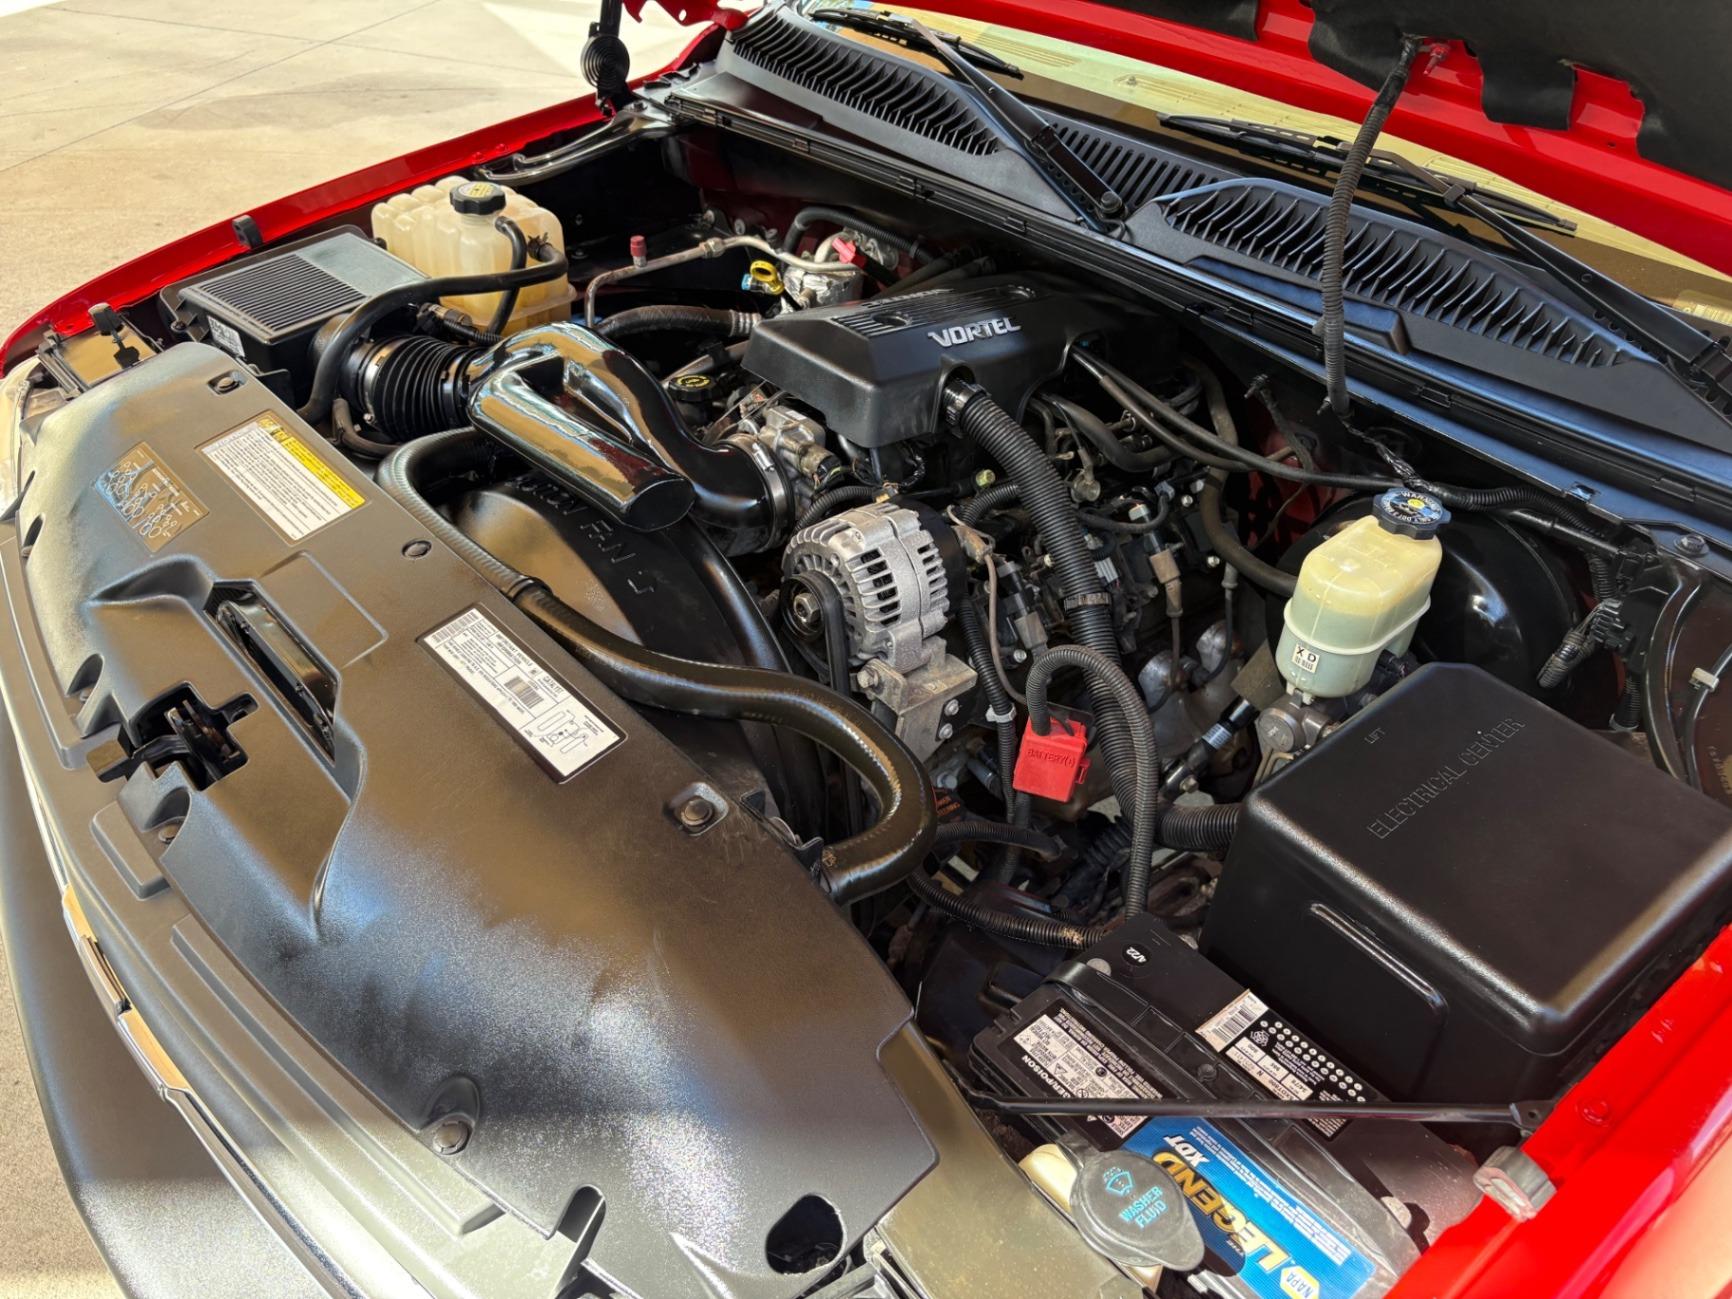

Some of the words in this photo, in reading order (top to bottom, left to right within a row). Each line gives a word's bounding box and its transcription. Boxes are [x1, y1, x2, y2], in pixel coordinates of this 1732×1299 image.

[1364, 727, 1387, 744] LIFT
[1366, 765, 1468, 839] ELECTRICAL
[1458, 718, 1526, 766] CENTER
[1021, 1055, 1071, 1099] GER/POISON
[1162, 1135, 1210, 1168] XDT
[1118, 1185, 1165, 1222] WASHER
[1134, 1199, 1169, 1229] FLUID
[1152, 1151, 1293, 1274] LEGEND
[1284, 1271, 1314, 1299] NAPA
